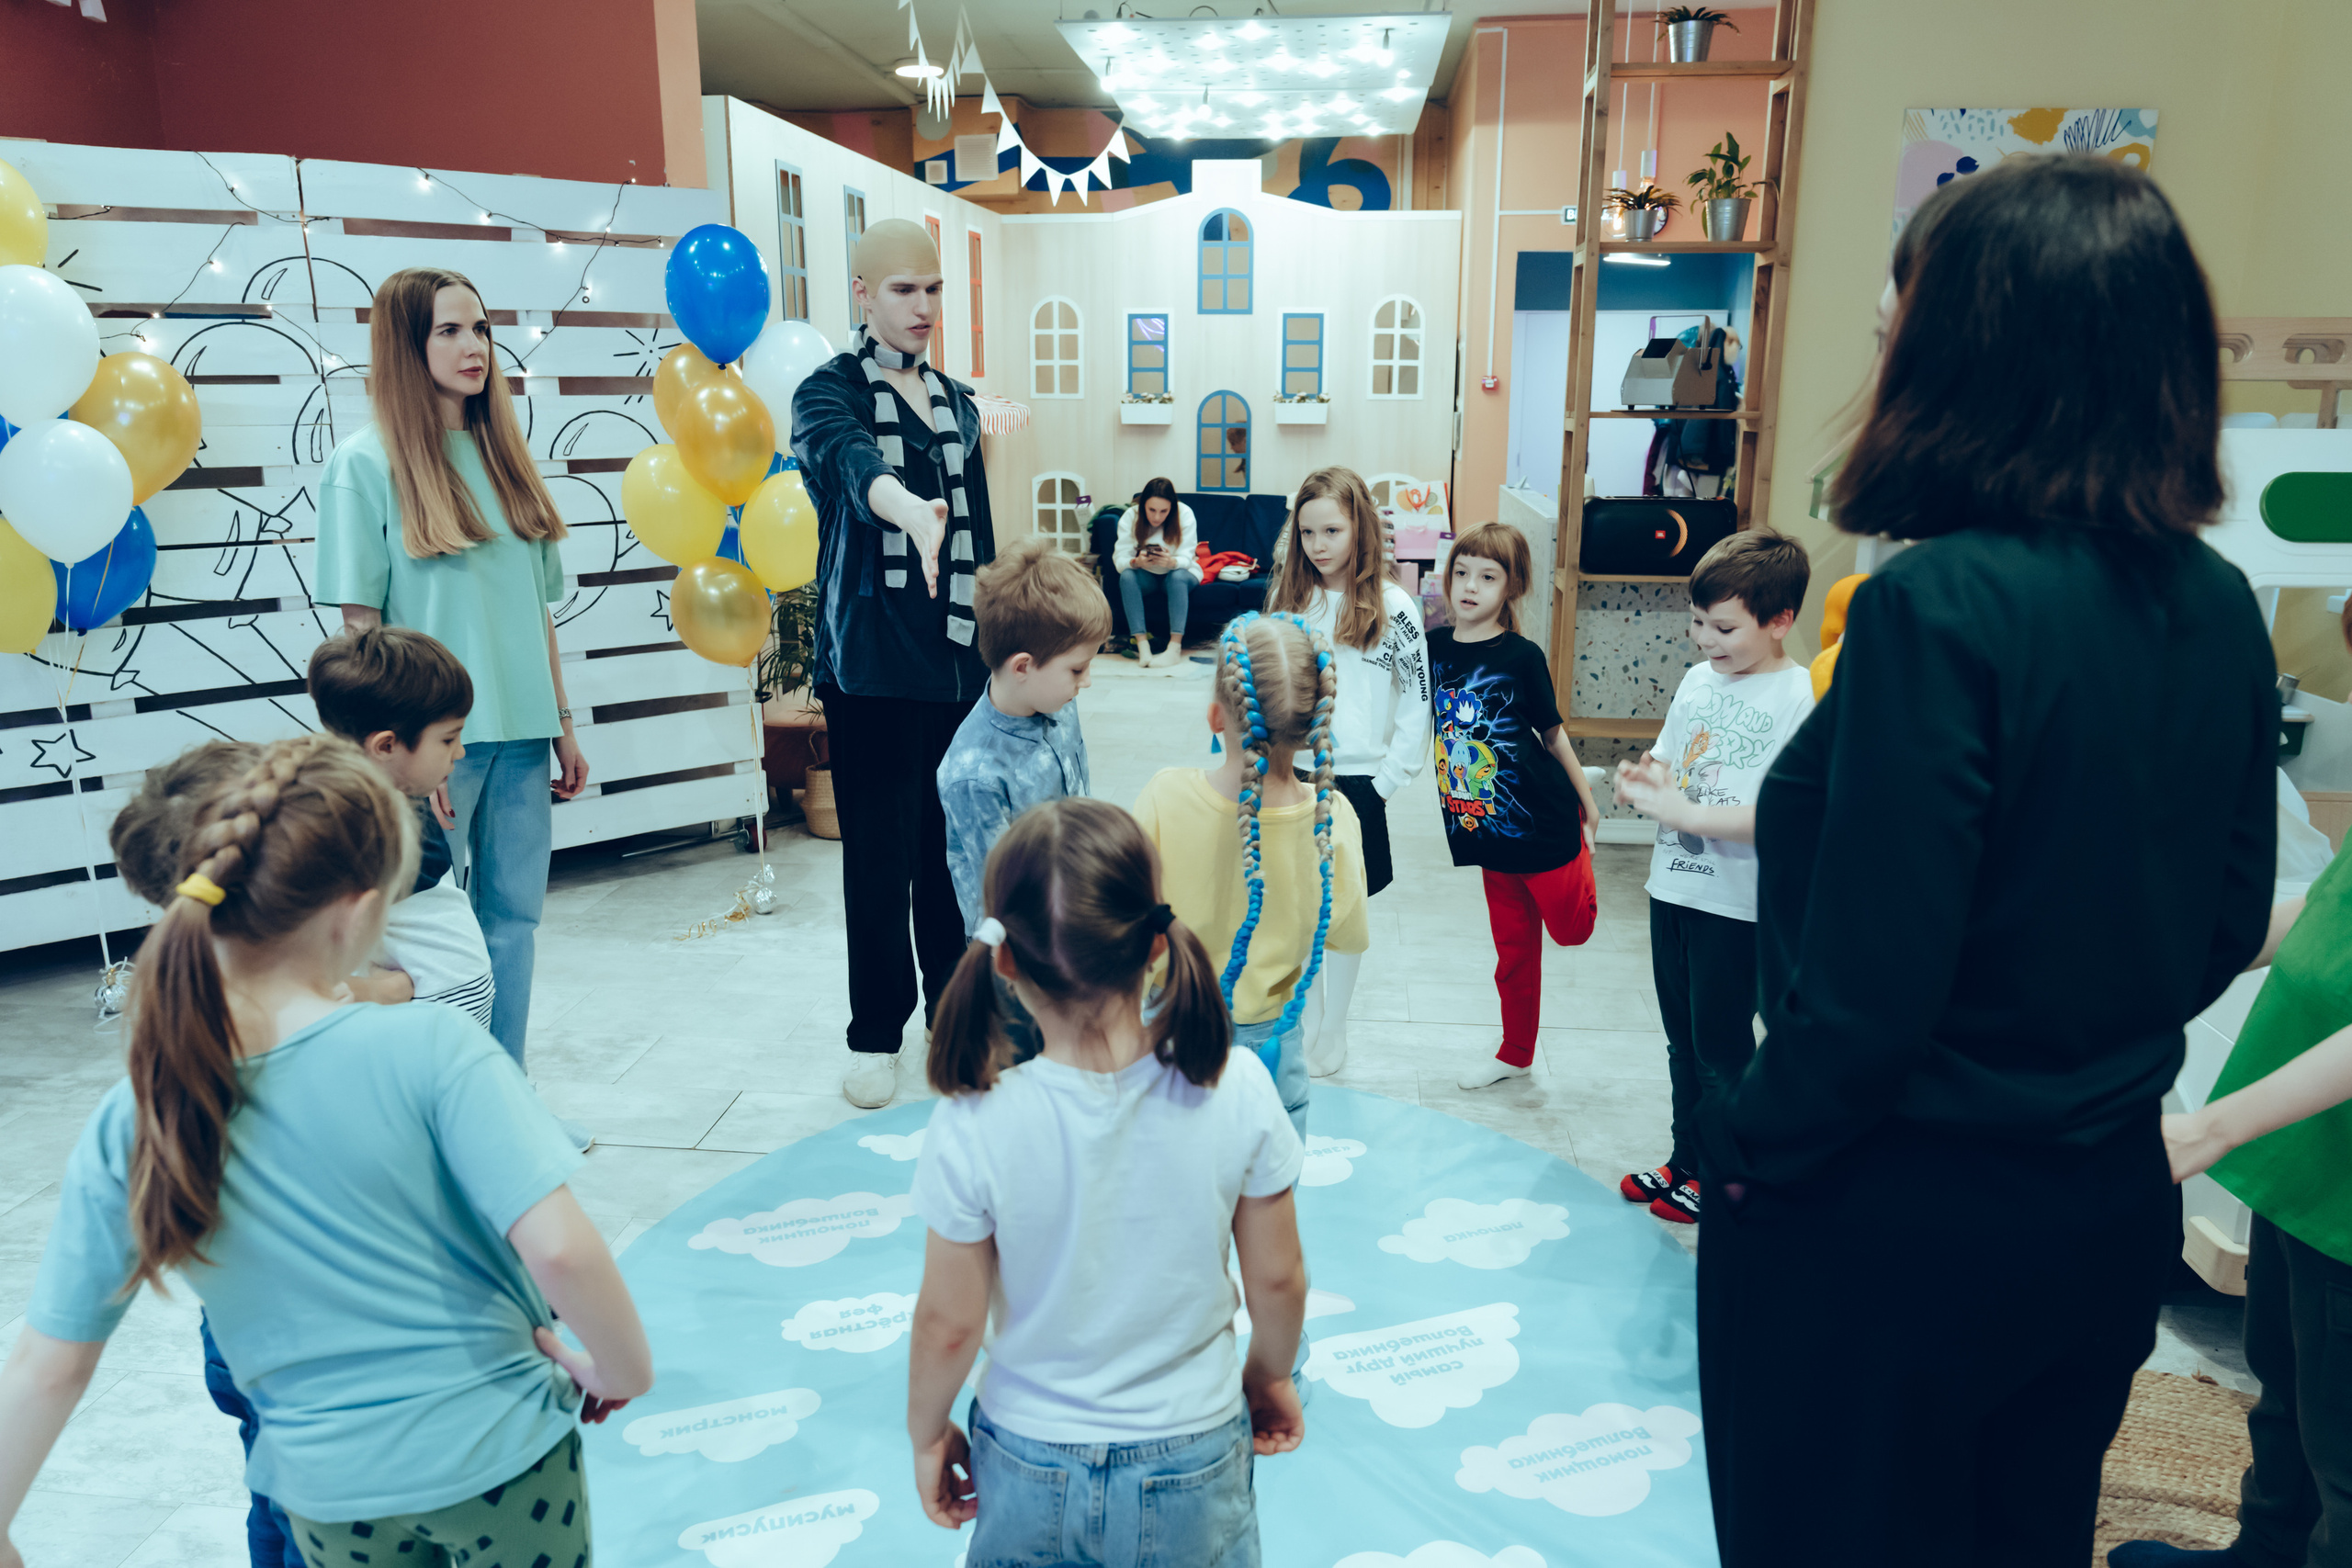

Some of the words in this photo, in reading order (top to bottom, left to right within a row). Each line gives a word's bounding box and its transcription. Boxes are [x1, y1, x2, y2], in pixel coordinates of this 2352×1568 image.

[1396, 610, 1419, 639] BLESS
[1416, 665, 1429, 702] YOUNG
[1736, 706, 1773, 734] AND
[1445, 795, 1486, 817] STARS
[743, 1207, 880, 1235] Волшебника
[757, 1219, 871, 1245] помощник
[1442, 1221, 1525, 1243] лапочка
[839, 1303, 883, 1319] фея
[1332, 1325, 1476, 1360] Волшебника
[1398, 1337, 1486, 1367] лучший
[1346, 1356, 1396, 1374] друг
[1389, 1360, 1464, 1386] самый
[659, 1404, 788, 1439] монстрик
[1507, 1426, 1653, 1470] Волшебника
[1533, 1445, 1654, 1483] помощник
[700, 1503, 856, 1544] мусипусик
